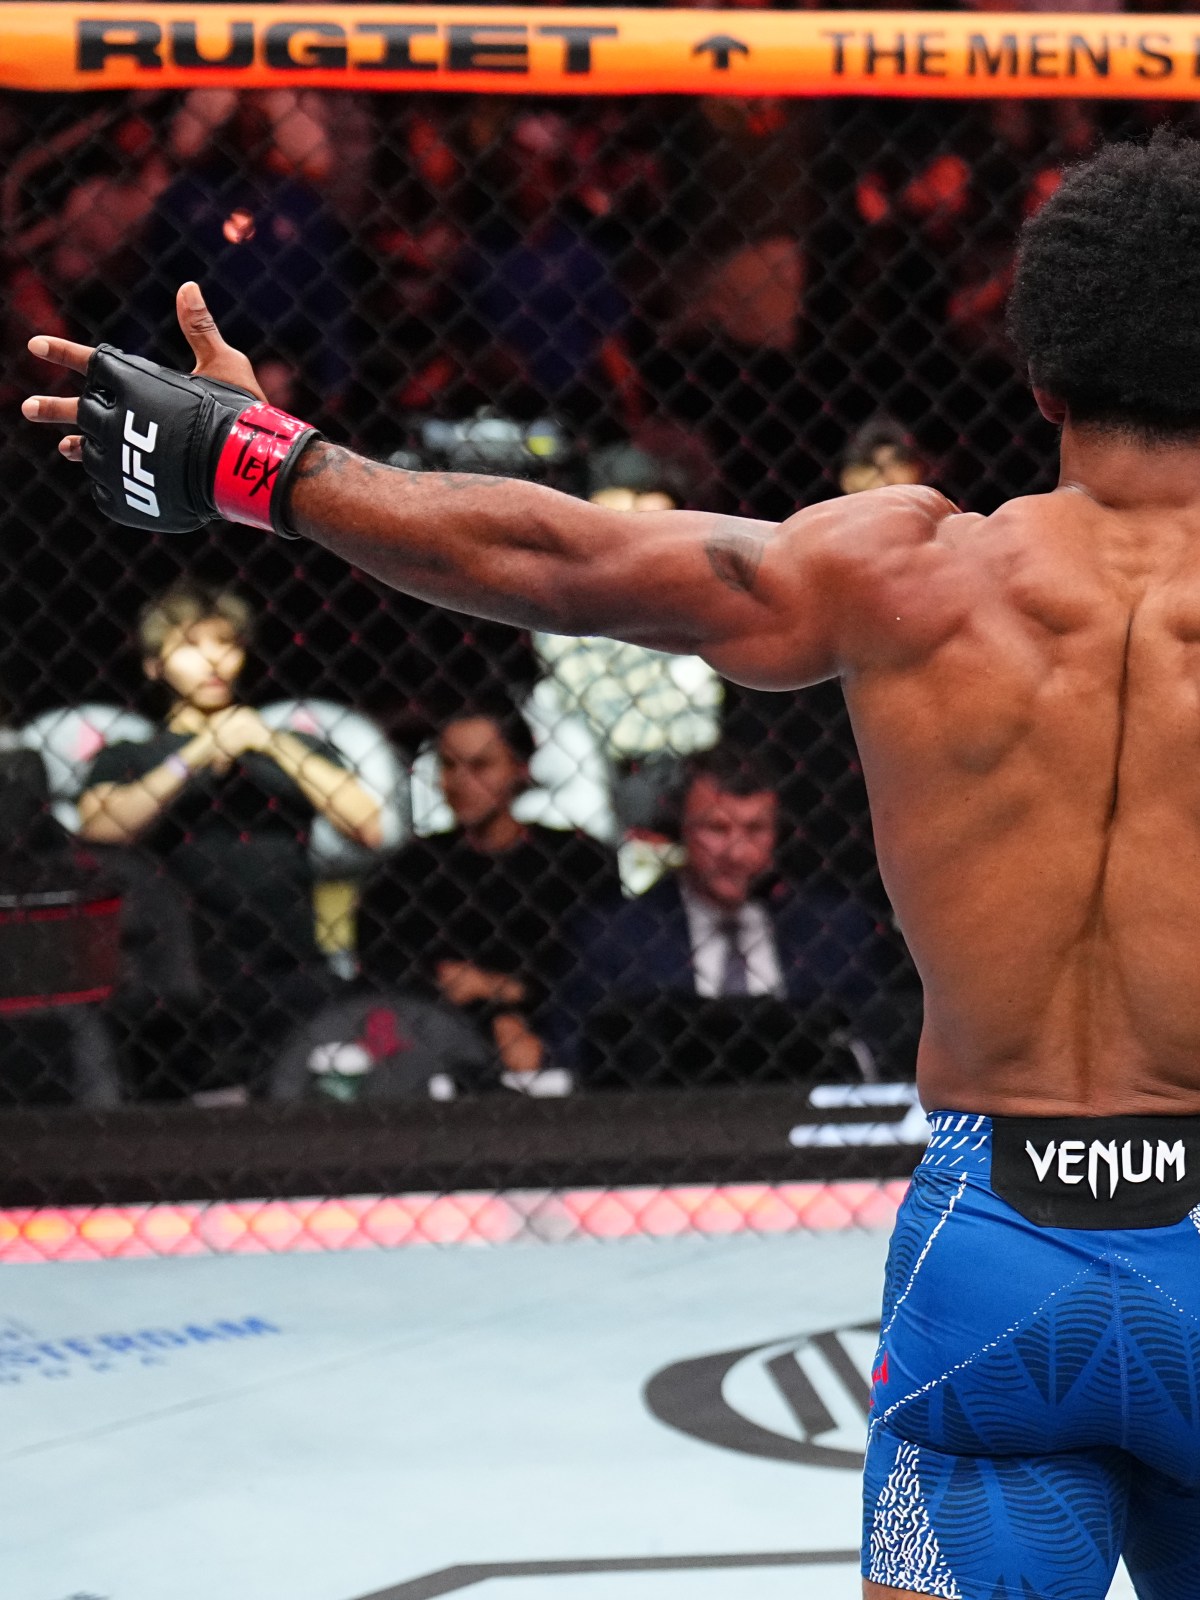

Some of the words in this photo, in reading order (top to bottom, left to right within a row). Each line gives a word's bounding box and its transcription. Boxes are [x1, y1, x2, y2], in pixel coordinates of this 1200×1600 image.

[75, 19, 619, 75] RUGIET
[822, 31, 947, 77] THE
[966, 33, 1174, 79] MEN'S
[122, 409, 160, 517] UFC
[1024, 1139, 1186, 1200] VENUM
